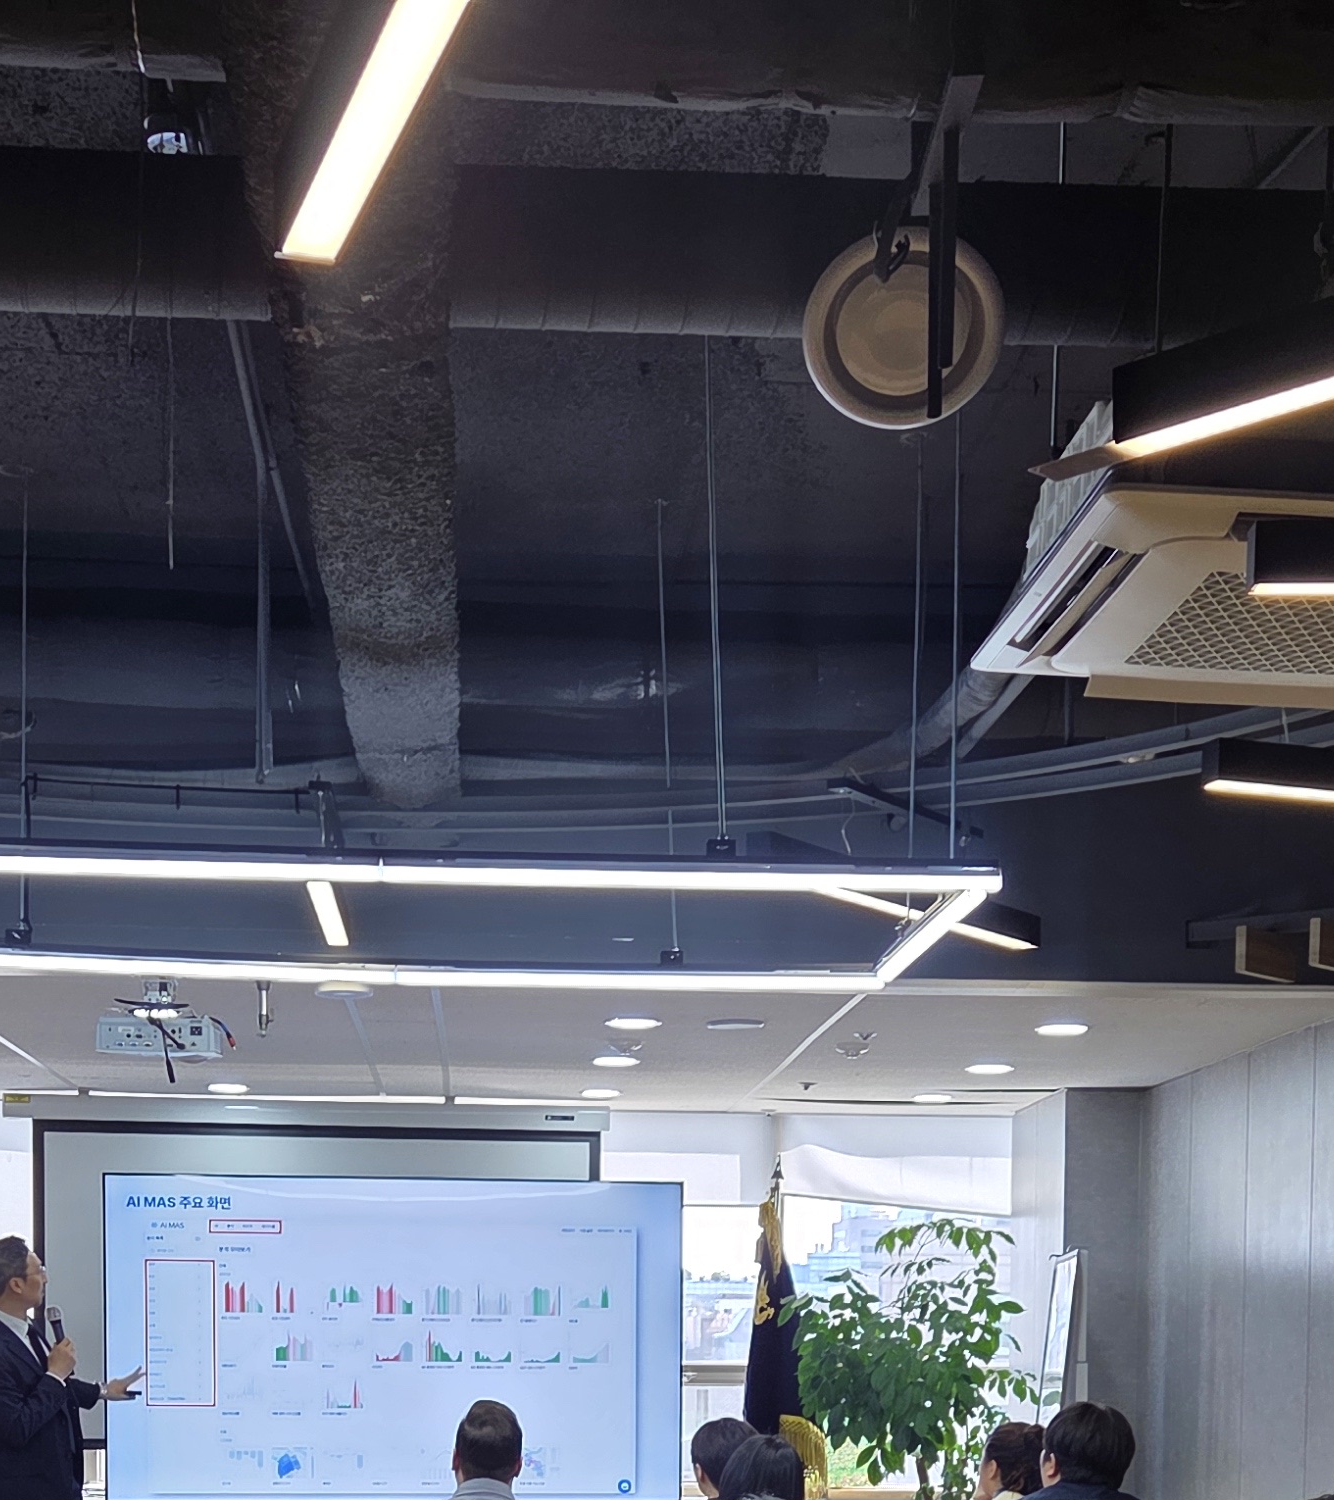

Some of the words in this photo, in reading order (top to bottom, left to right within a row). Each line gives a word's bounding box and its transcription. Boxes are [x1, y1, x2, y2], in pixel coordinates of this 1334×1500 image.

[126, 1196, 140, 1208] AI
[144, 1196, 176, 1208] MAS
[179, 1196, 204, 1210] 주요
[206, 1195, 231, 1210] 화면
